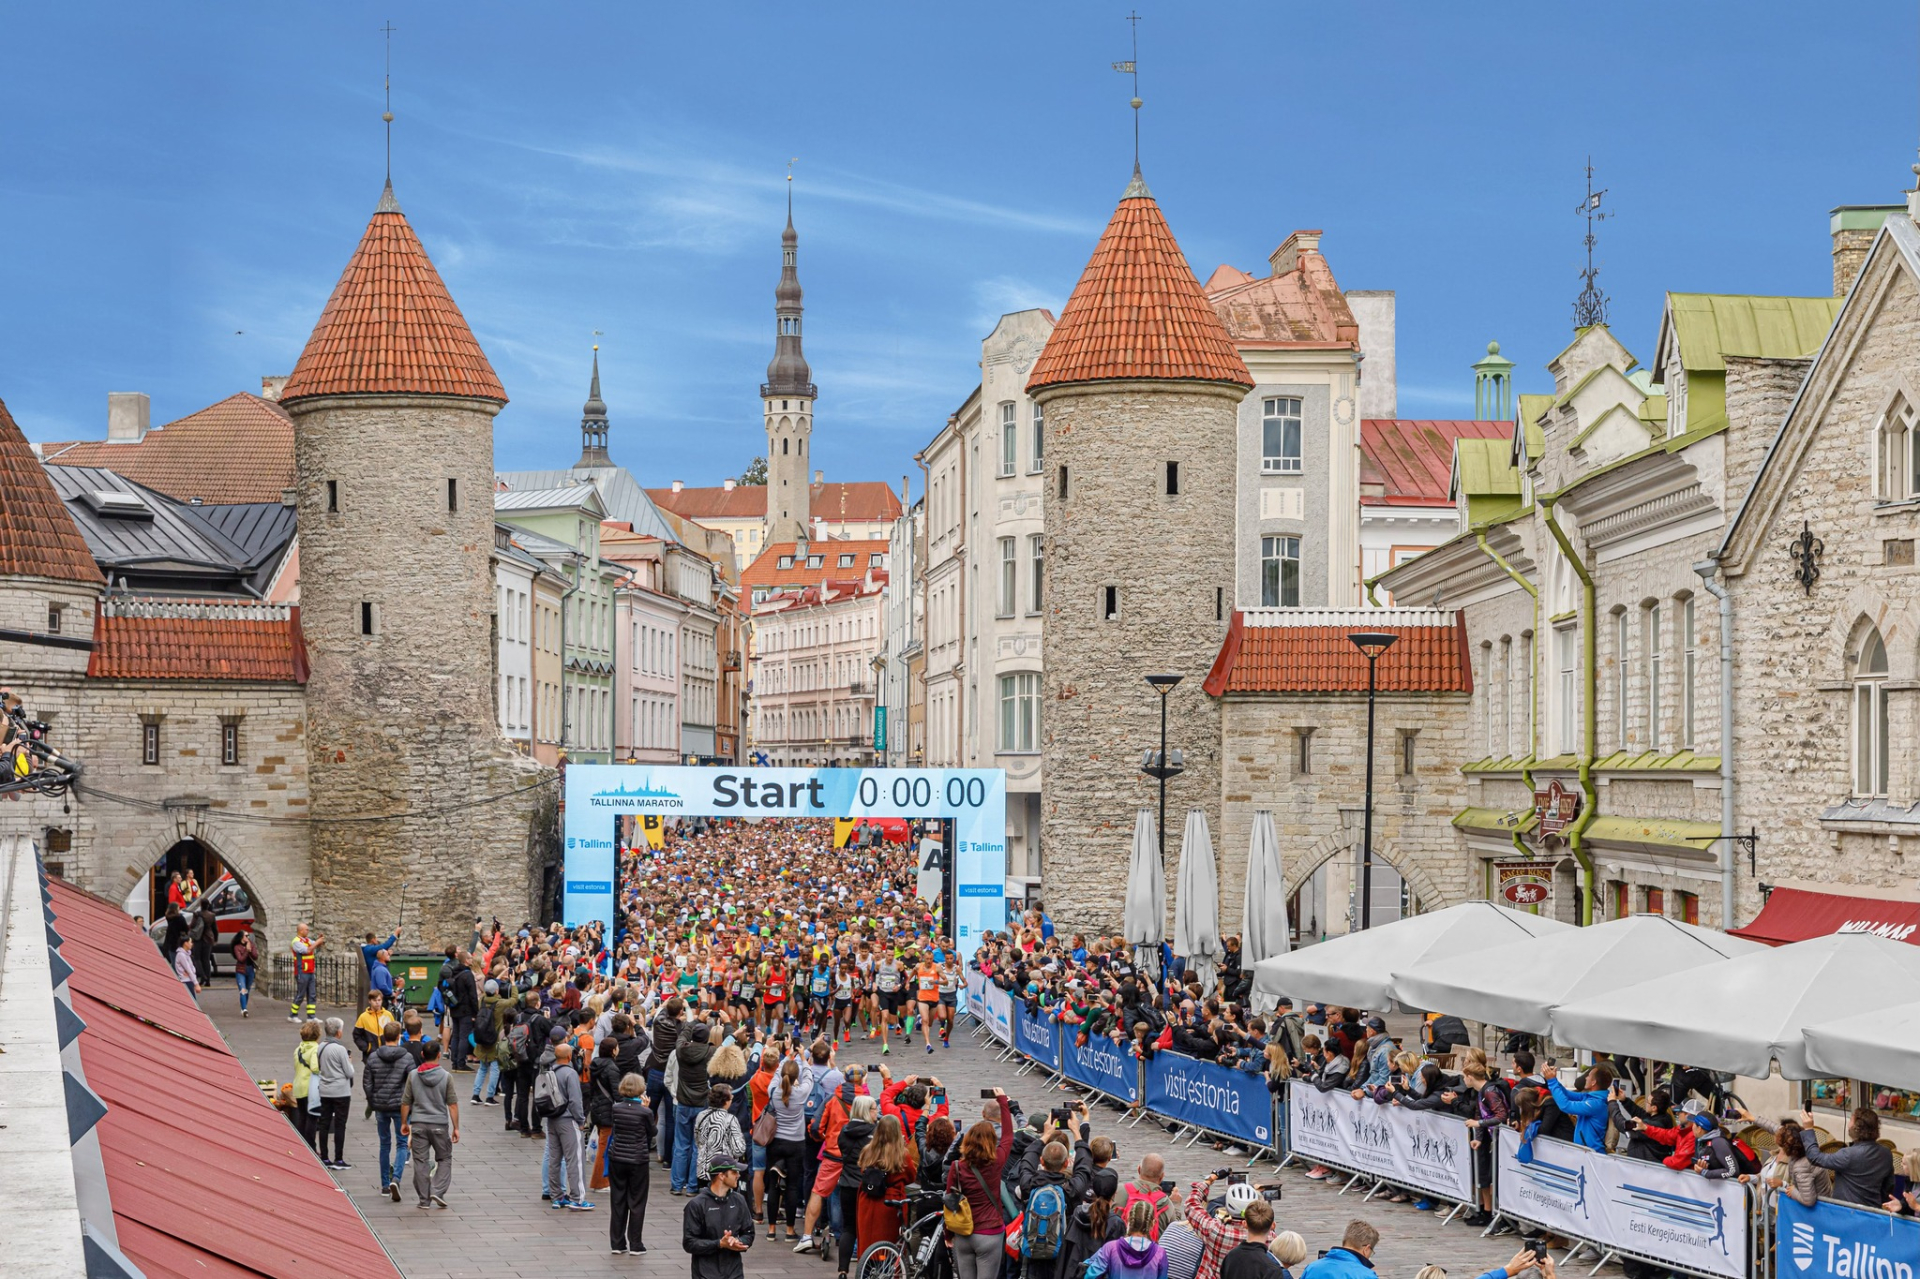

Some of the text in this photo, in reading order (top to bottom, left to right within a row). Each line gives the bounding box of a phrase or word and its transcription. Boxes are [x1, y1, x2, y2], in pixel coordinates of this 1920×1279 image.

[590, 798, 684, 808] TALLINNA MARATON
[712, 774, 826, 809] Start
[644, 814, 660, 830] B
[579, 839, 612, 849] Tallinn
[970, 842, 1004, 852] Tallinn
[922, 848, 944, 872] A
[1031, 1019, 1050, 1048] estonia
[1077, 1042, 1122, 1078] visit estonia
[1164, 1067, 1239, 1115] visit estonia
[1519, 1186, 1533, 1198] Eesti
[1629, 1219, 1707, 1249] Eesti Kergejõustikuliit
[1822, 1234, 1913, 1279] Tallinn
